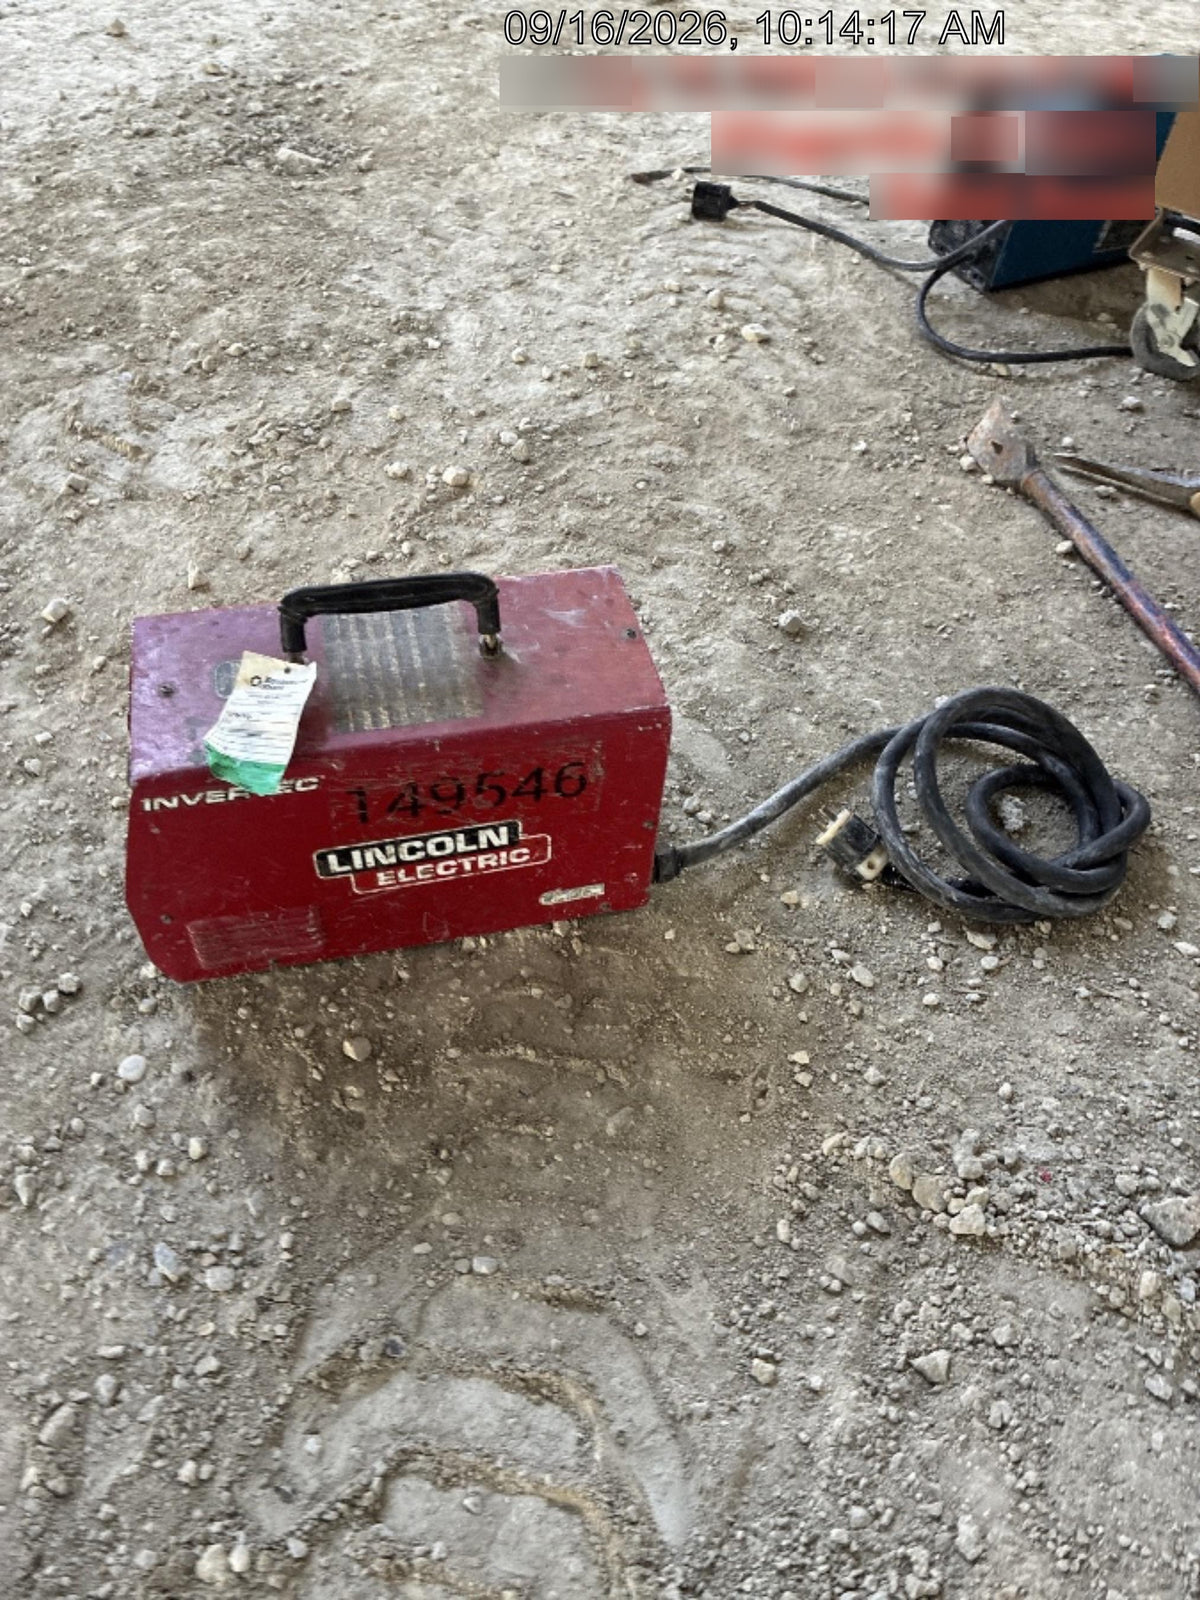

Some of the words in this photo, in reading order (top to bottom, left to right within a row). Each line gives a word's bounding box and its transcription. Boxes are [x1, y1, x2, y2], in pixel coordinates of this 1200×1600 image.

[142, 777, 320, 812] INVEREC
[346, 761, 588, 824] 149546
[326, 825, 511, 875] LINCOLN
[376, 848, 531, 886] ELECTRIC
